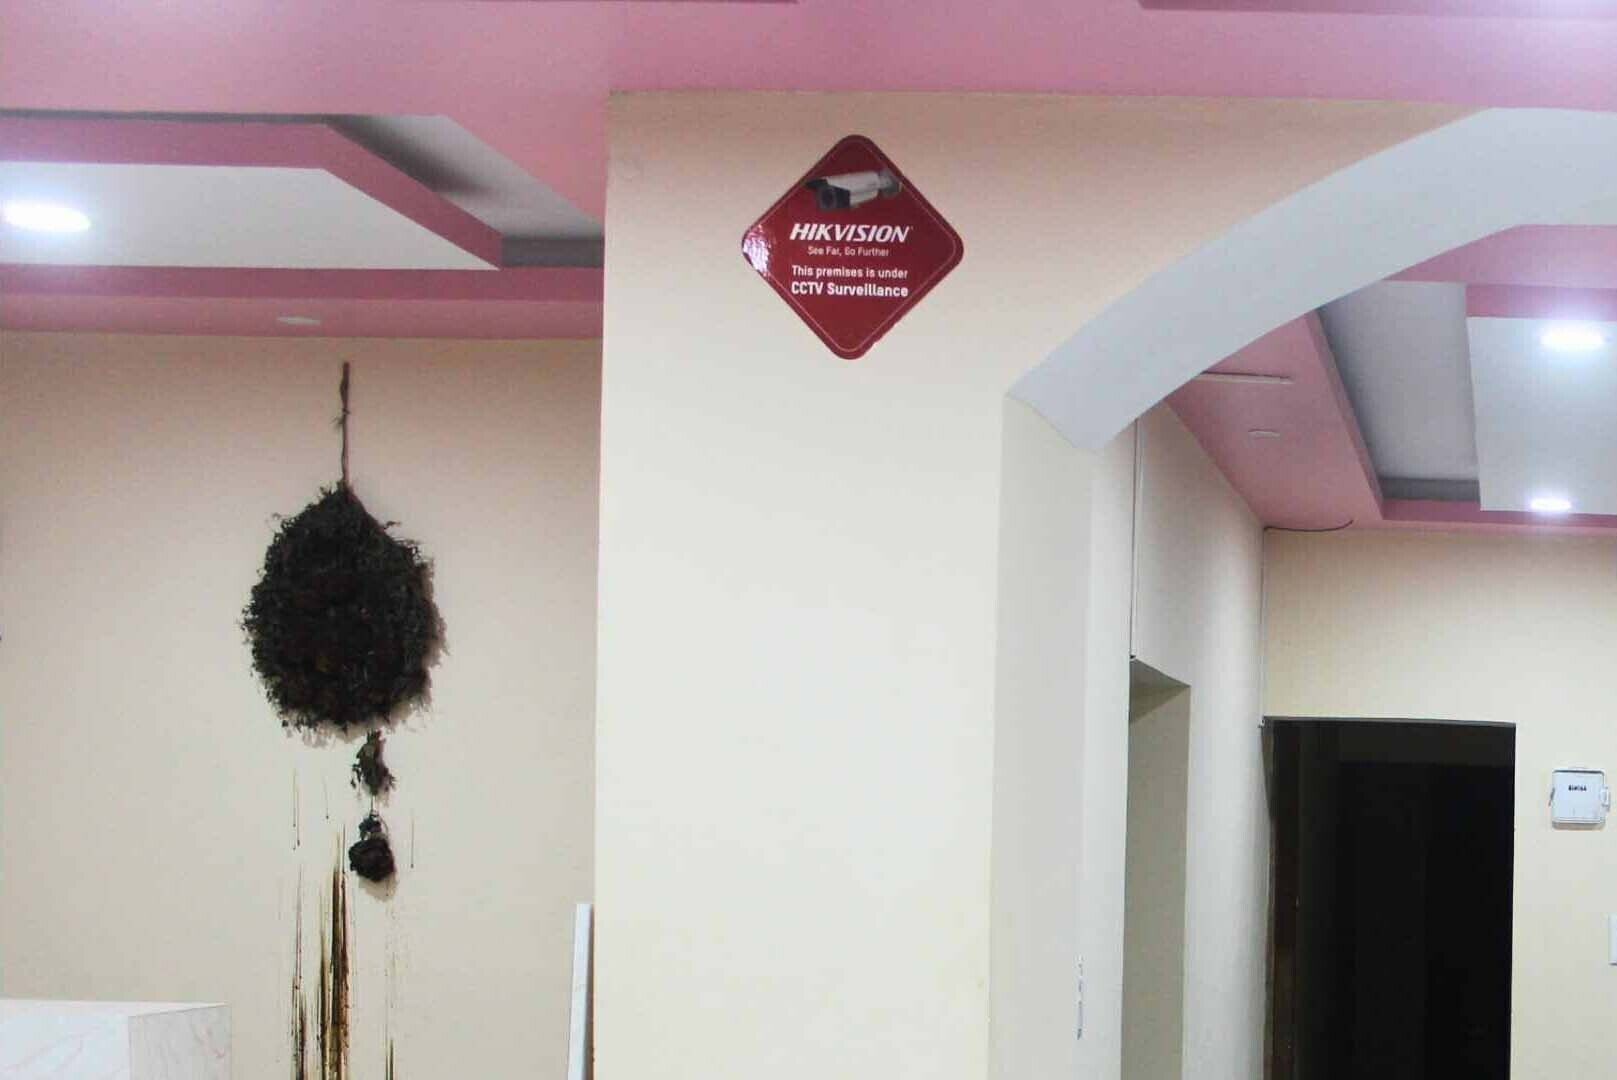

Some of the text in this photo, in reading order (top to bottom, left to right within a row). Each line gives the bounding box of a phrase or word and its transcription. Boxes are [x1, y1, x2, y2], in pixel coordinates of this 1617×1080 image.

[789, 223, 910, 242] HIKVISION
[808, 246, 889, 257] See Far, Go Further
[792, 265, 908, 279] This premises is under
[791, 281, 909, 297] CCTV Surveillance
